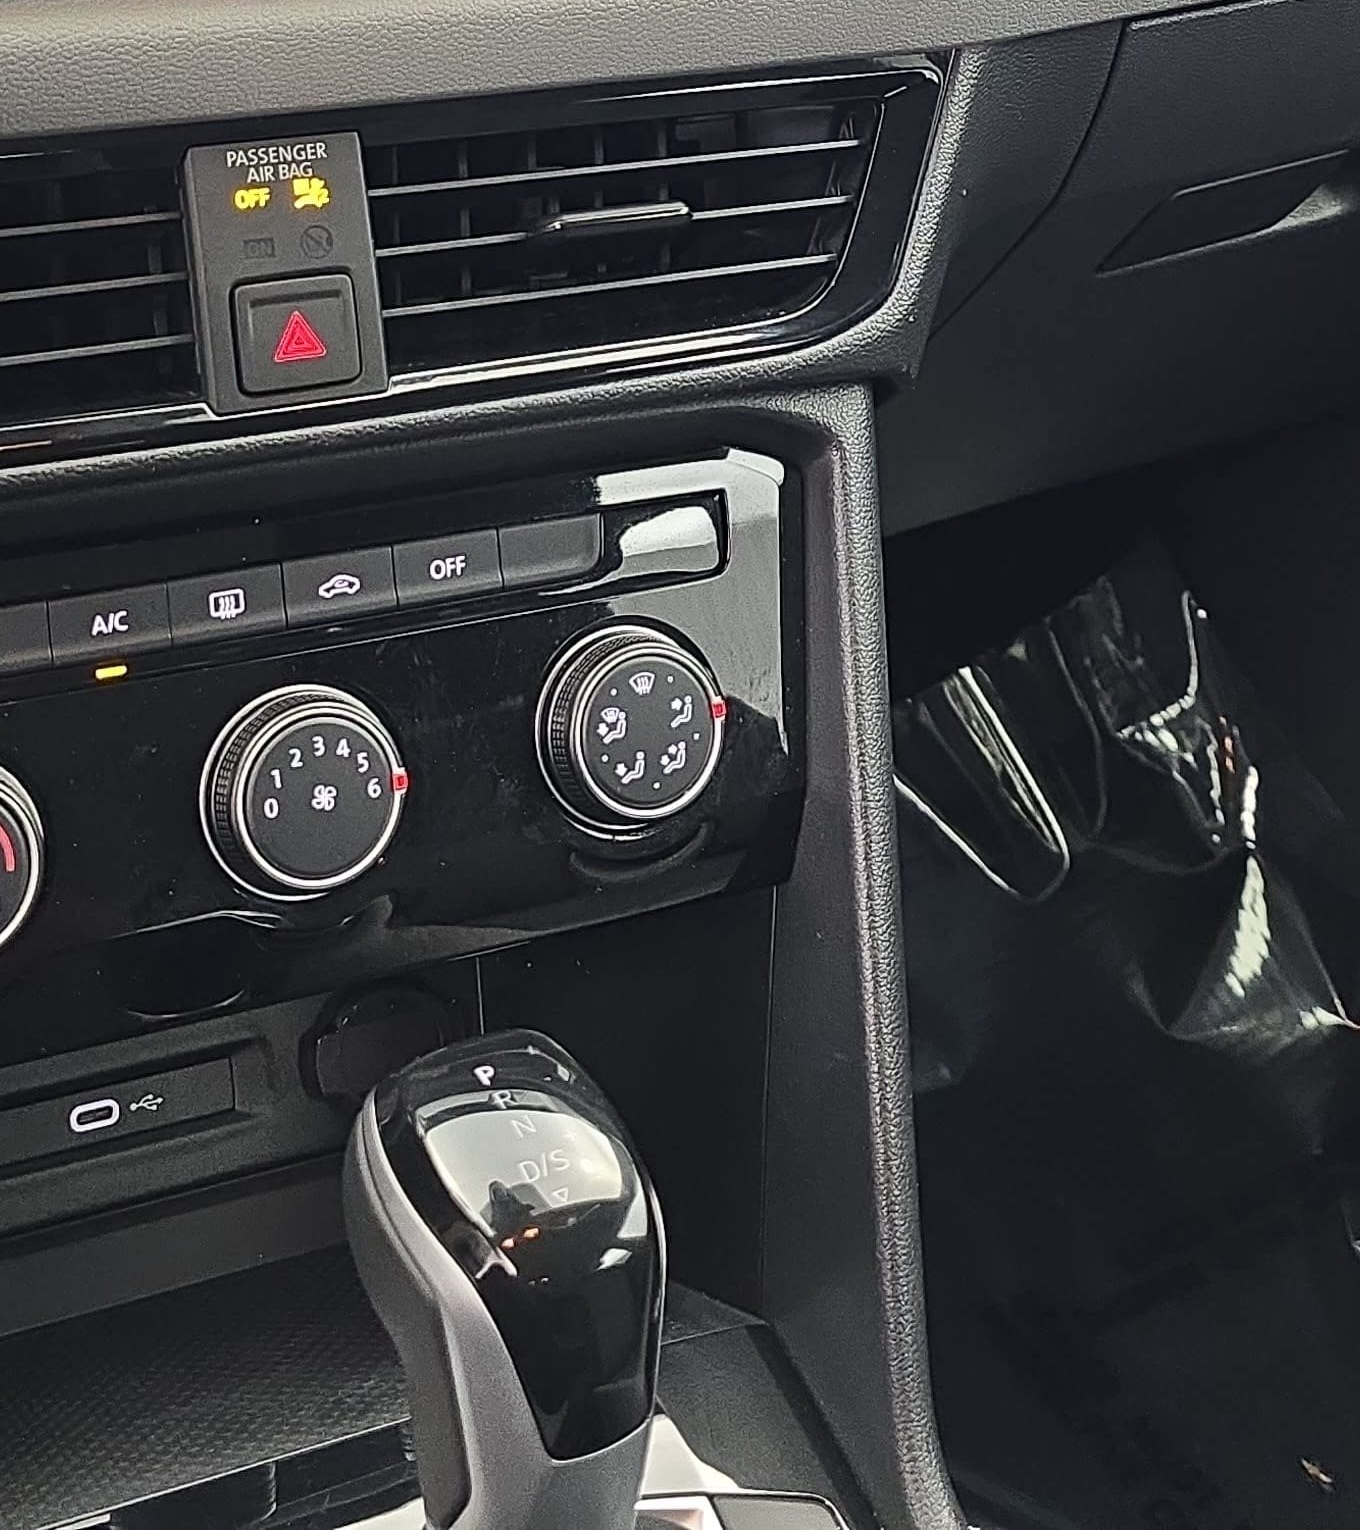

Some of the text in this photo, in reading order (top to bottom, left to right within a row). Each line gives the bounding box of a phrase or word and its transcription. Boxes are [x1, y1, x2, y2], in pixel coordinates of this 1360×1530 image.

[226, 142, 328, 167] PASSENGER
[247, 162, 314, 183] AIR BAG
[234, 187, 272, 210] OFF
[246, 240, 273, 257] ON
[429, 555, 468, 581] OFF
[91, 610, 129, 637] A/C
[311, 735, 326, 757] 3
[336, 738, 351, 758] 4
[288, 748, 303, 768] 2
[356, 752, 369, 773] 5
[270, 769, 282, 789] 1
[367, 778, 381, 799] 6
[263, 798, 279, 819] 0
[473, 1064, 496, 1086] P
[492, 1089, 514, 1109] R
[511, 1115, 537, 1139] N
[518, 1148, 571, 1183] D/S
